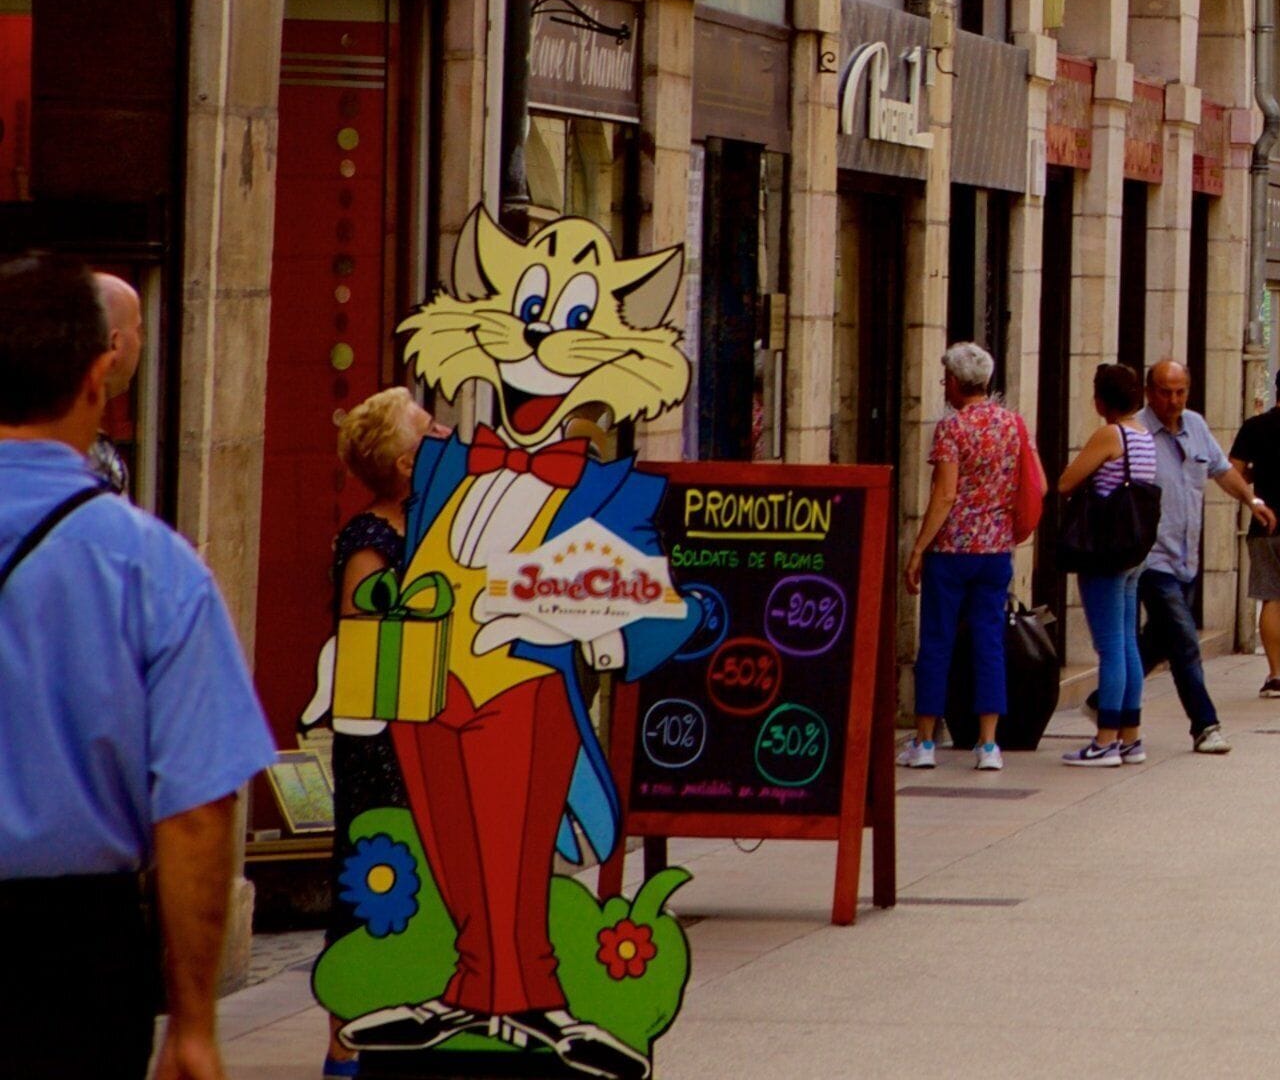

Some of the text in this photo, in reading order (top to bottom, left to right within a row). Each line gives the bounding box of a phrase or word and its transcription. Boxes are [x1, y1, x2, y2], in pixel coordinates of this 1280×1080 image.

[671, 544, 825, 570] SOLDATS DE PLOMB
[771, 592, 838, 631] -20%
[712, 656, 773, 691] -50%
[646, 713, 697, 748] -10%
[761, 722, 820, 756] -30%
